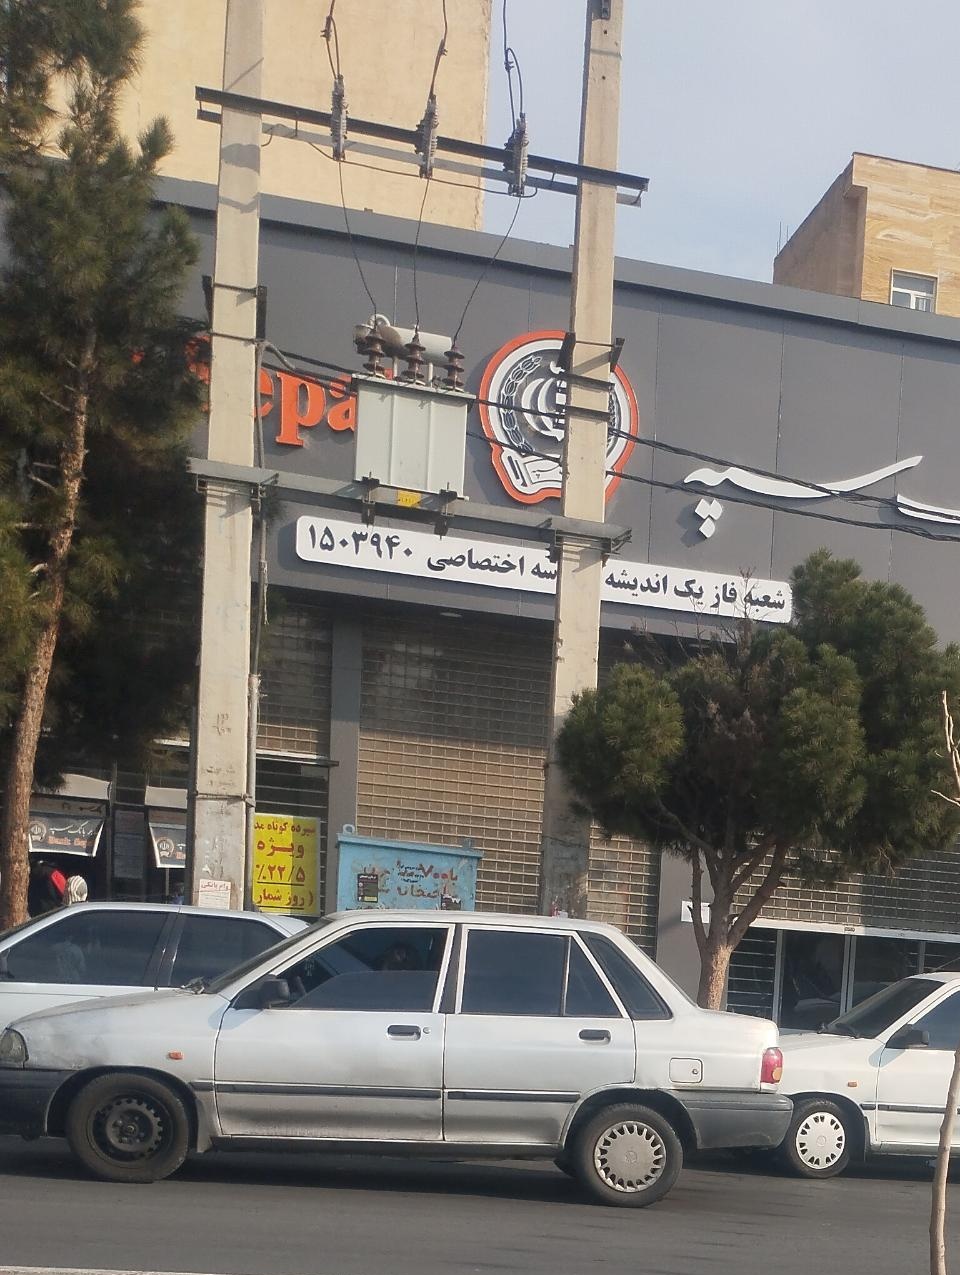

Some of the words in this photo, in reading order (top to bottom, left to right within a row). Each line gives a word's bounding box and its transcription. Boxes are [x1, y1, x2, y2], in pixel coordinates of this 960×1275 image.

[683, 455, 924, 539] سپه
[308, 524, 413, 561] ۱۵۰۳۹۴۰
[426, 548, 525, 576] اختصاصی
[604, 569, 668, 598] اندیشه
[673, 578, 704, 605] یک
[709, 580, 738, 609] فاز
[743, 589, 786, 613] شعبه
[254, 821, 265, 830] مد
[256, 836, 305, 859] ویژه
